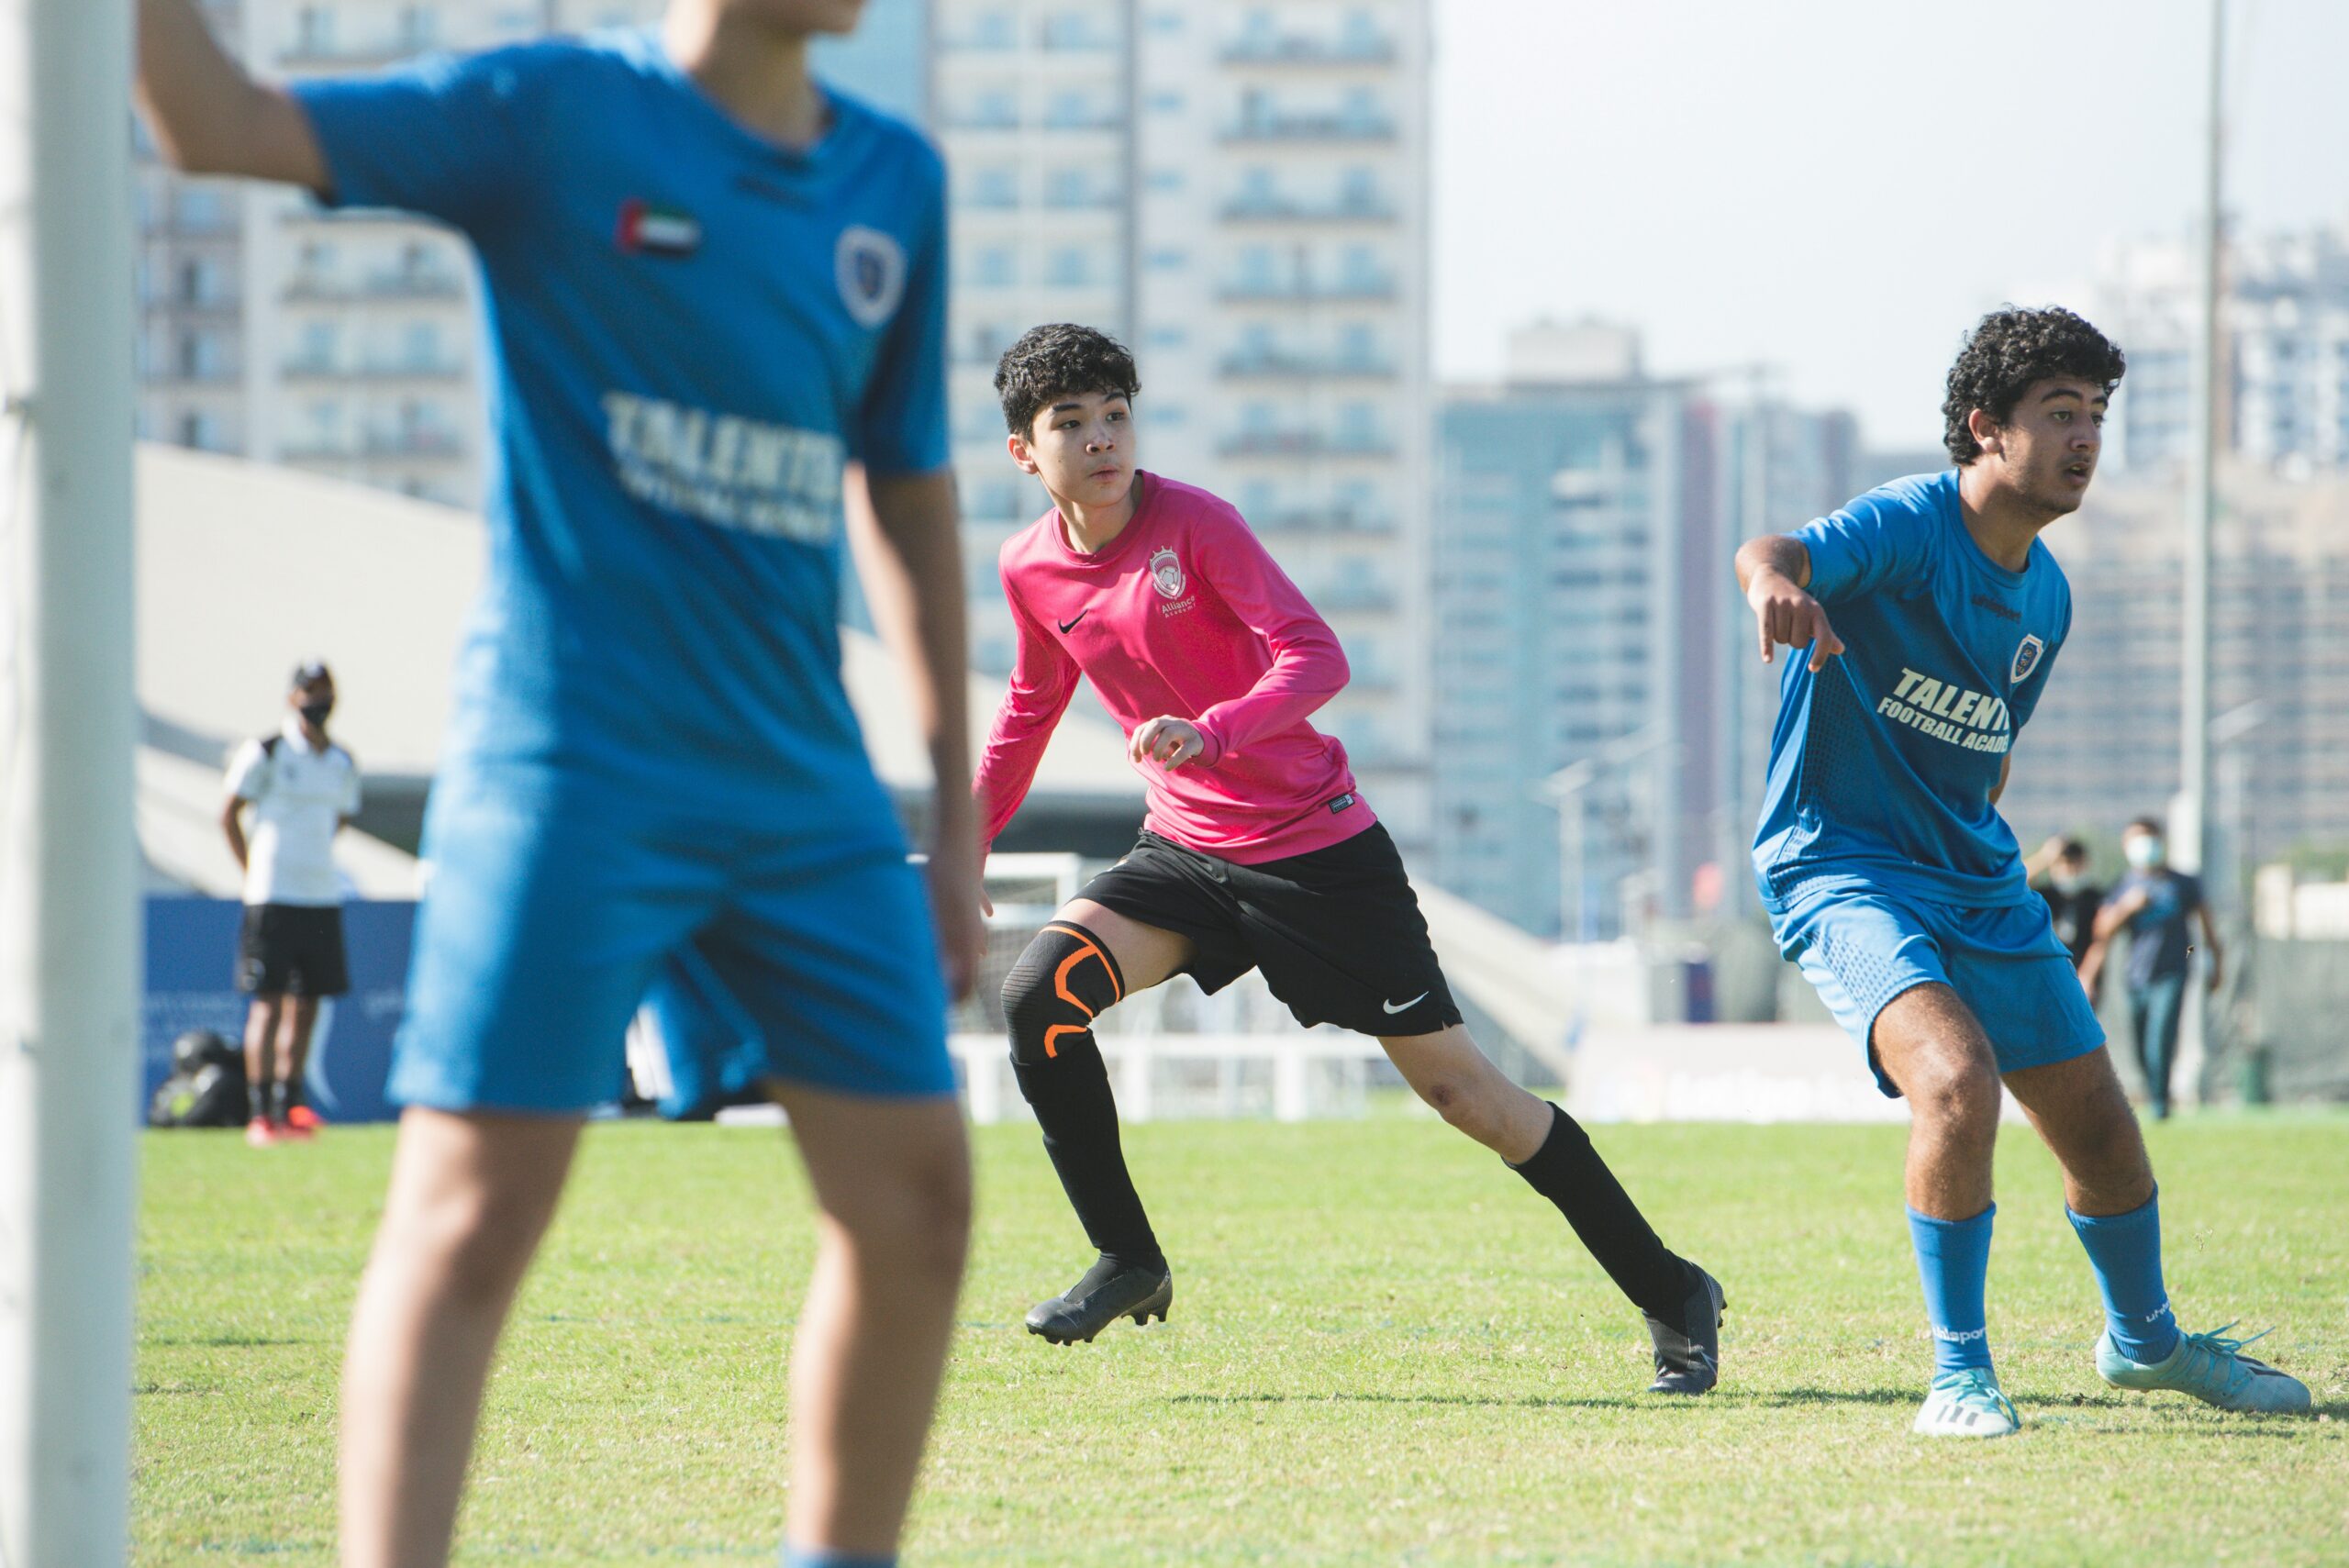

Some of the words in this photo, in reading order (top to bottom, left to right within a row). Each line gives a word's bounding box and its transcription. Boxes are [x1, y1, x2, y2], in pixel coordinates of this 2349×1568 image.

[1162, 595, 1196, 614] Alliance
[1876, 697, 1959, 744] FOOTBALL
[1961, 734, 2009, 752] ACADE
[1932, 1326, 1986, 1345] uhlspor
